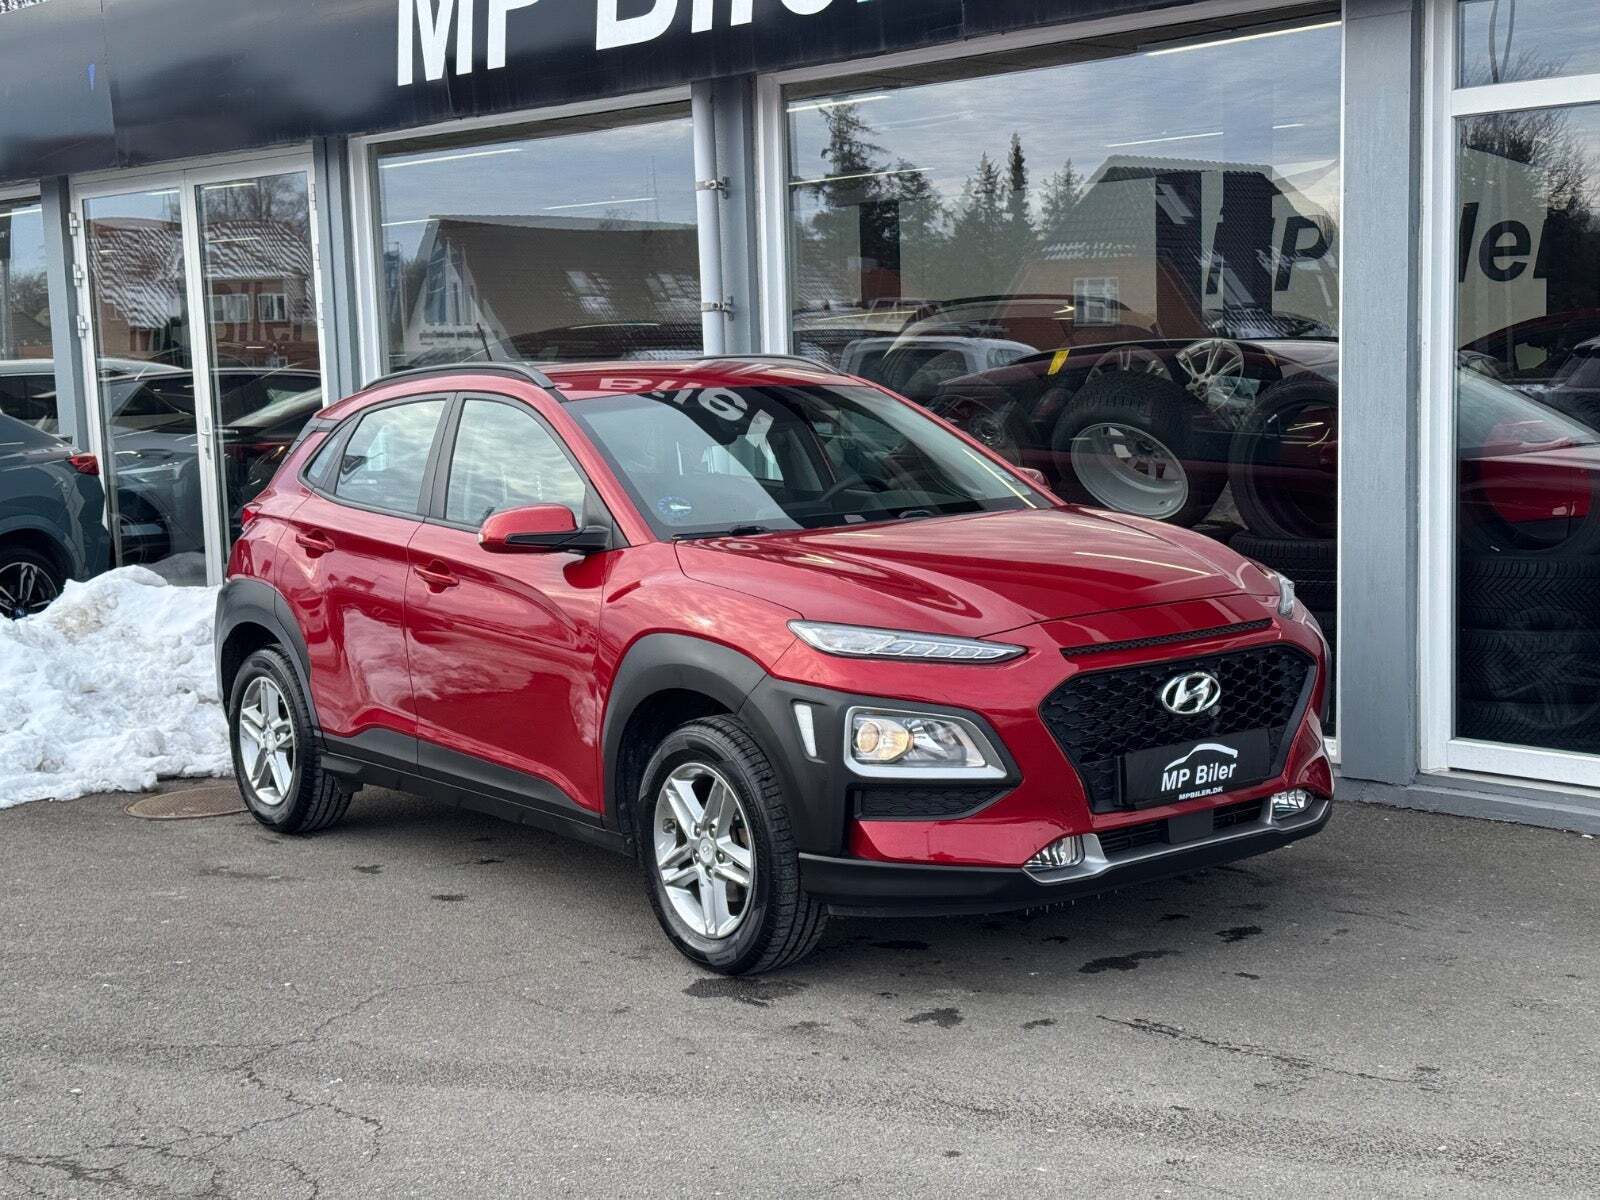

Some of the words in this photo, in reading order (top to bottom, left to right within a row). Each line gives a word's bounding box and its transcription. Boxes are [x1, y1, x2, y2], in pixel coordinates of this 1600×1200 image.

[1161, 768, 1190, 791] MP
[1196, 763, 1236, 784] Biler
[1179, 787, 1223, 800] MPBILER.DK
